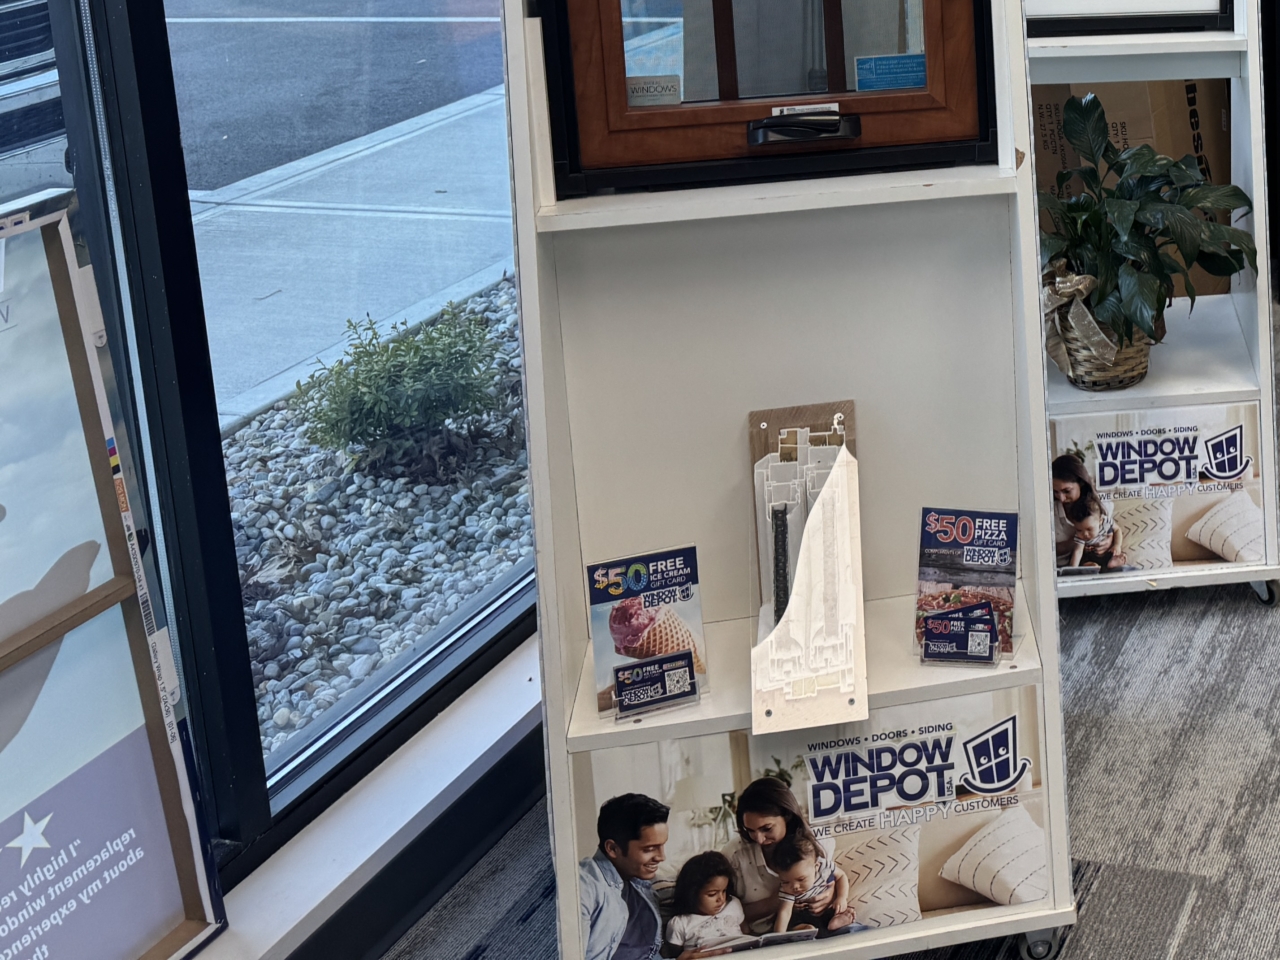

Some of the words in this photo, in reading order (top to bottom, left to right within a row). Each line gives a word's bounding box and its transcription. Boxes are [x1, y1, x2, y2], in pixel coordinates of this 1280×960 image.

[630, 85, 677, 94] WINDOWS
[1042, 140, 1049, 150] KG
[1096, 430, 1133, 439] WINDOWS
[1141, 428, 1166, 436] DOORS
[1097, 436, 1198, 461] WINDOW
[1099, 455, 1198, 486] DEPOT
[1099, 492, 1111, 500] WE
[1113, 490, 1142, 499] CREATE
[1145, 482, 1197, 499] HAPPY
[1198, 482, 1244, 492] CUSTOMERS
[926, 512, 974, 543] $50
[976, 519, 1007, 530] FREE
[975, 531, 1007, 540] PIZZA
[965, 547, 996, 557] WINDOW
[965, 555, 996, 564] DEPOT
[594, 562, 648, 596] $50
[649, 557, 684, 573] FREE
[650, 572, 663, 581] ICE
[664, 567, 690, 579] CREAM
[650, 579, 665, 588] GIFT
[666, 576, 686, 585] CARD
[643, 588, 678, 601] WINDOW
[643, 595, 677, 609] DEPOT
[927, 619, 950, 634] $50
[618, 667, 643, 684] $50
[643, 664, 659, 672] FREE
[808, 737, 861, 751] WINDOWS
[872, 730, 908, 742] DOORS
[918, 723, 953, 735] SIDING
[809, 736, 954, 782] WINDOW
[812, 763, 954, 819] DEPOT
[813, 826, 831, 838] WE
[834, 818, 875, 833] CREATE
[880, 802, 950, 829] HAPPY
[954, 796, 1019, 813] CUSTOMERS
